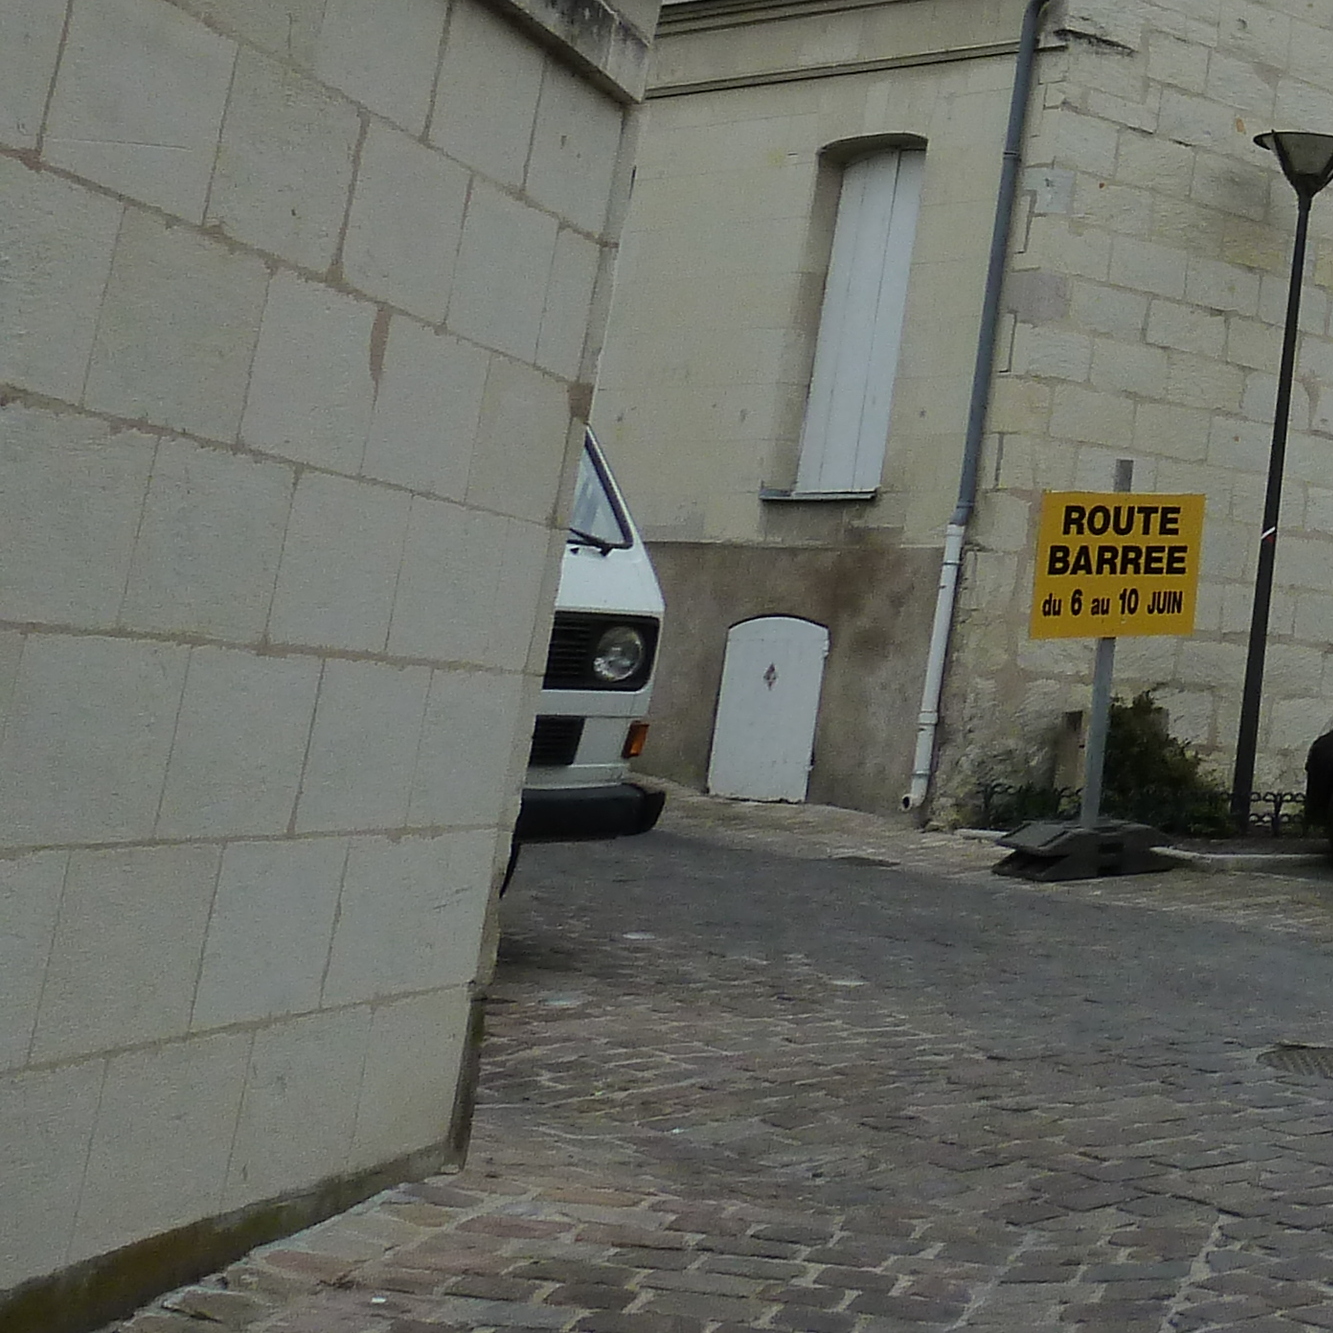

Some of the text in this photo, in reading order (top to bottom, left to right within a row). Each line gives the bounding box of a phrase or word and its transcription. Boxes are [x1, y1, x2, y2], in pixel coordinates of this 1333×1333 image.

[1062, 505, 1181, 536] ROUTE
[1047, 545, 1188, 575] BARREE
[1042, 588, 1182, 616] du 6 au 10 JUIN
